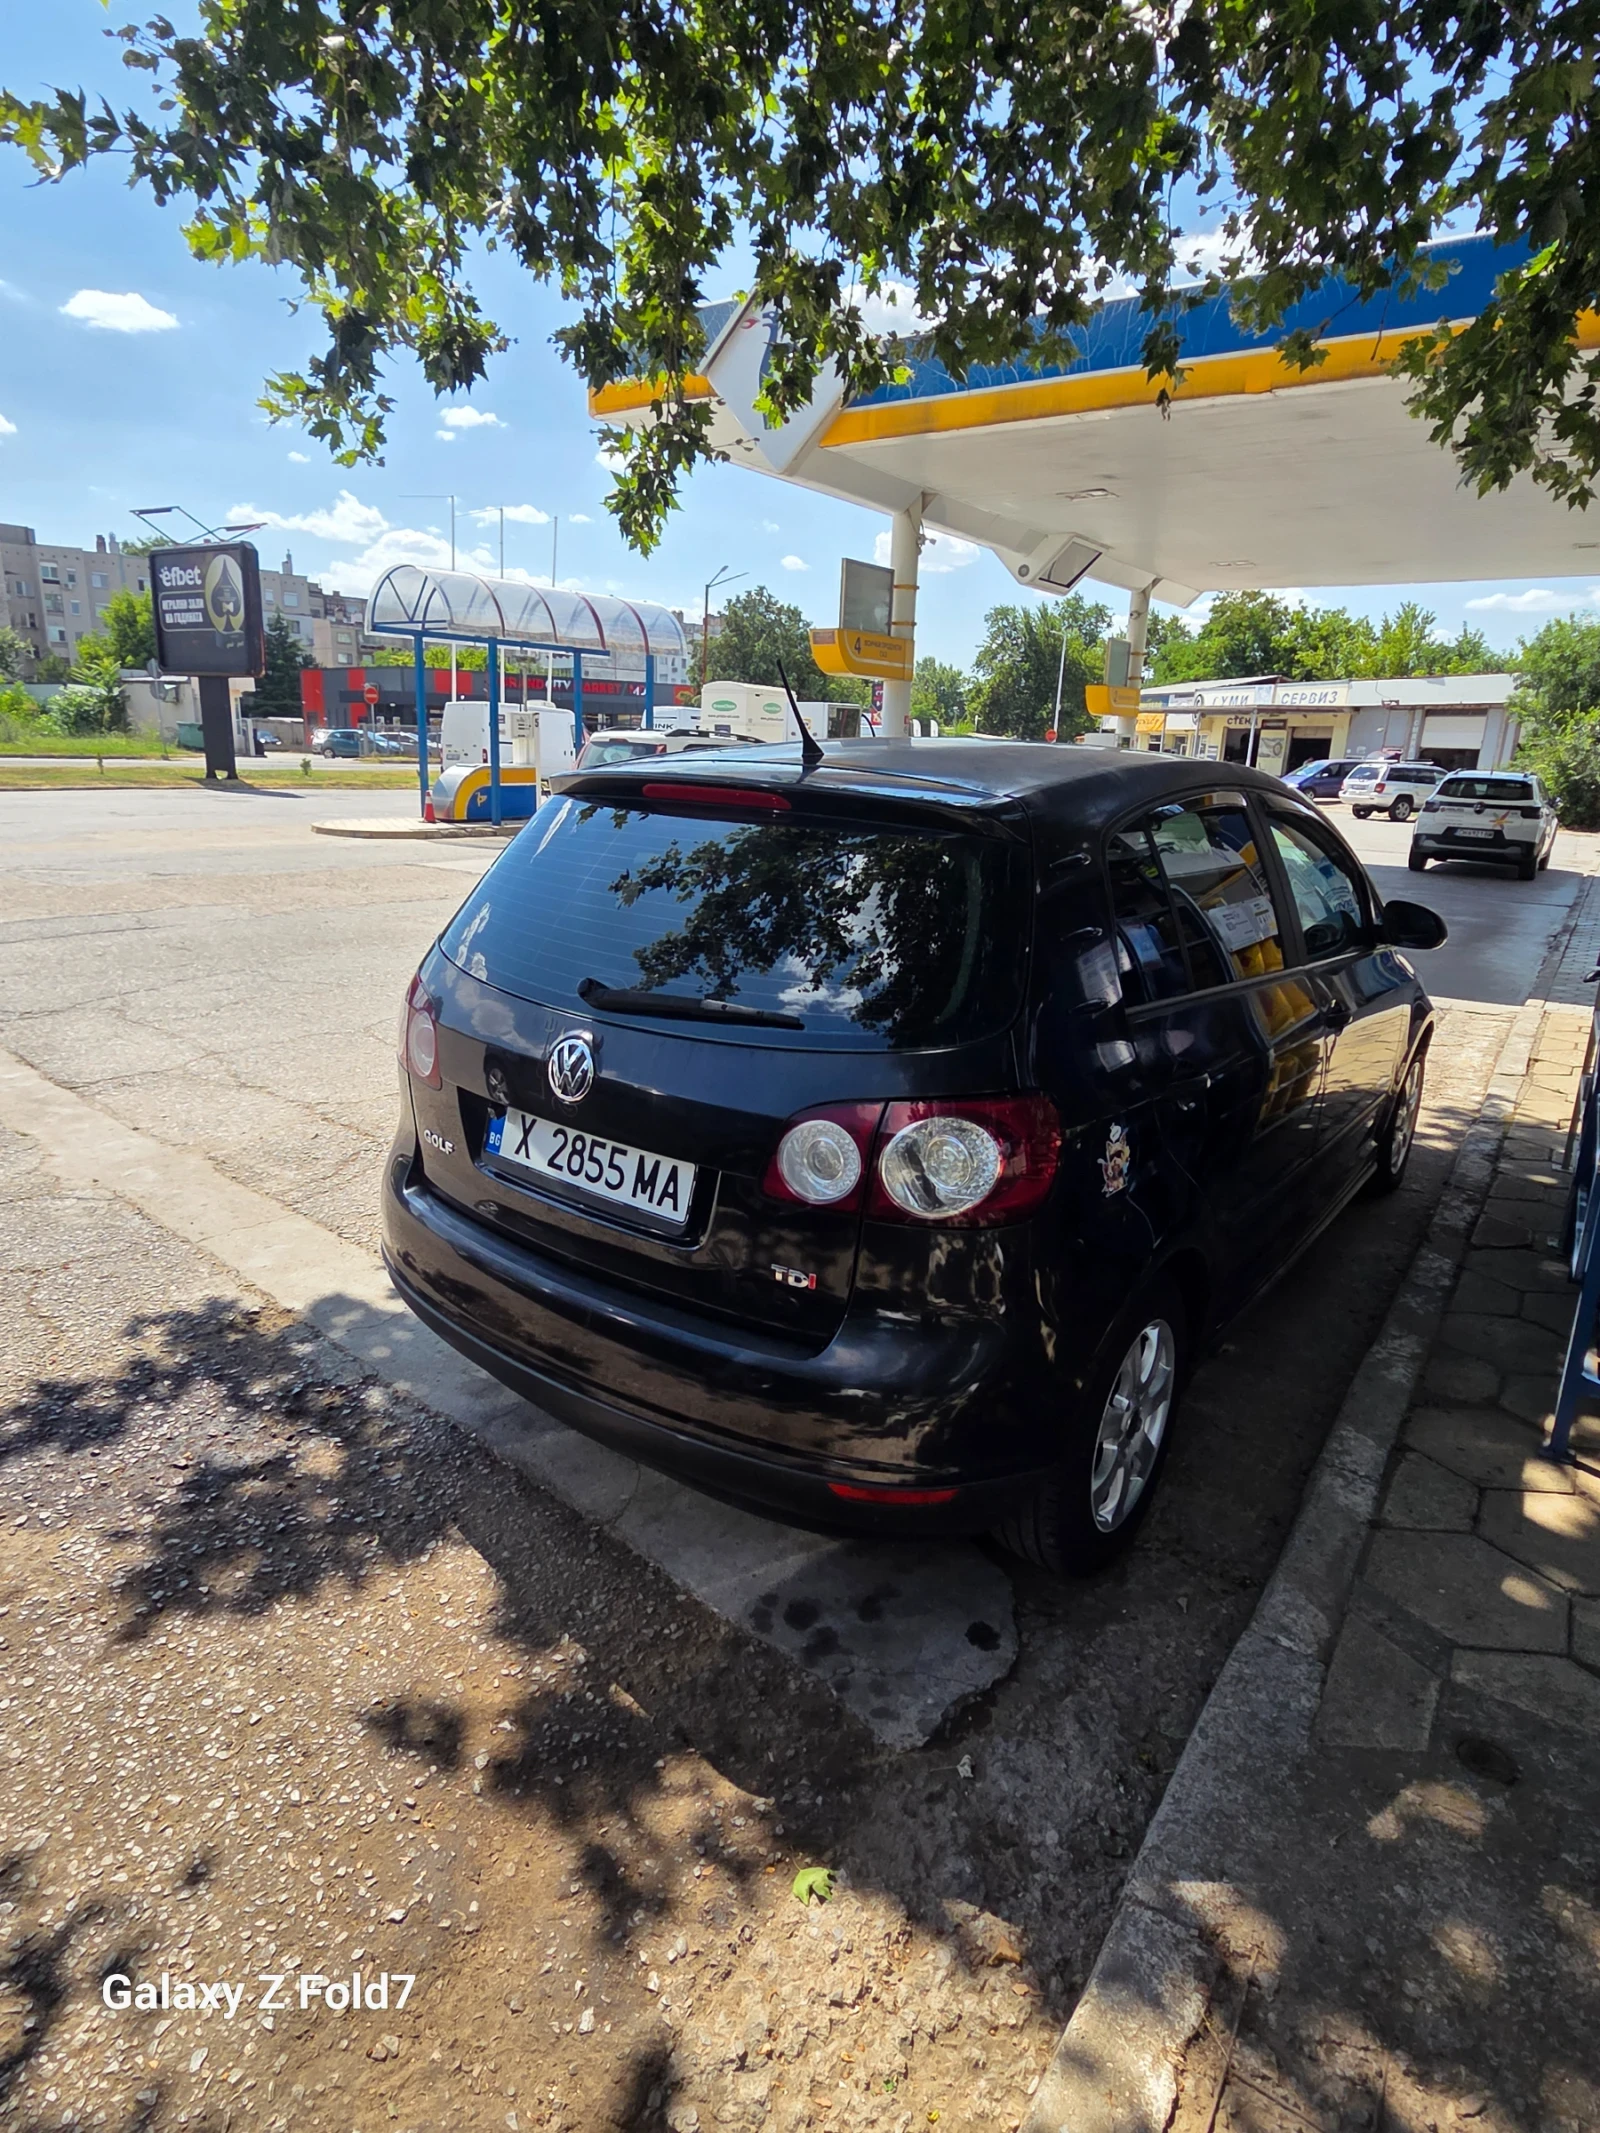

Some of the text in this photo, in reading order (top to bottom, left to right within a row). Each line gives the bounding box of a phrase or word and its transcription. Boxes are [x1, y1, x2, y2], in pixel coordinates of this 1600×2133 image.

[159, 565, 202, 587] efbet
[854, 636, 862, 654] 4
[583, 681, 621, 694] ARKET
[1281, 690, 1338, 705] СЕРВИЗ
[423, 1129, 456, 1155] GOLF
[489, 1131, 501, 1147] BG
[547, 1127, 628, 1191] 2855
[631, 1154, 680, 1212] MA
[771, 1262, 818, 1290] TDI
